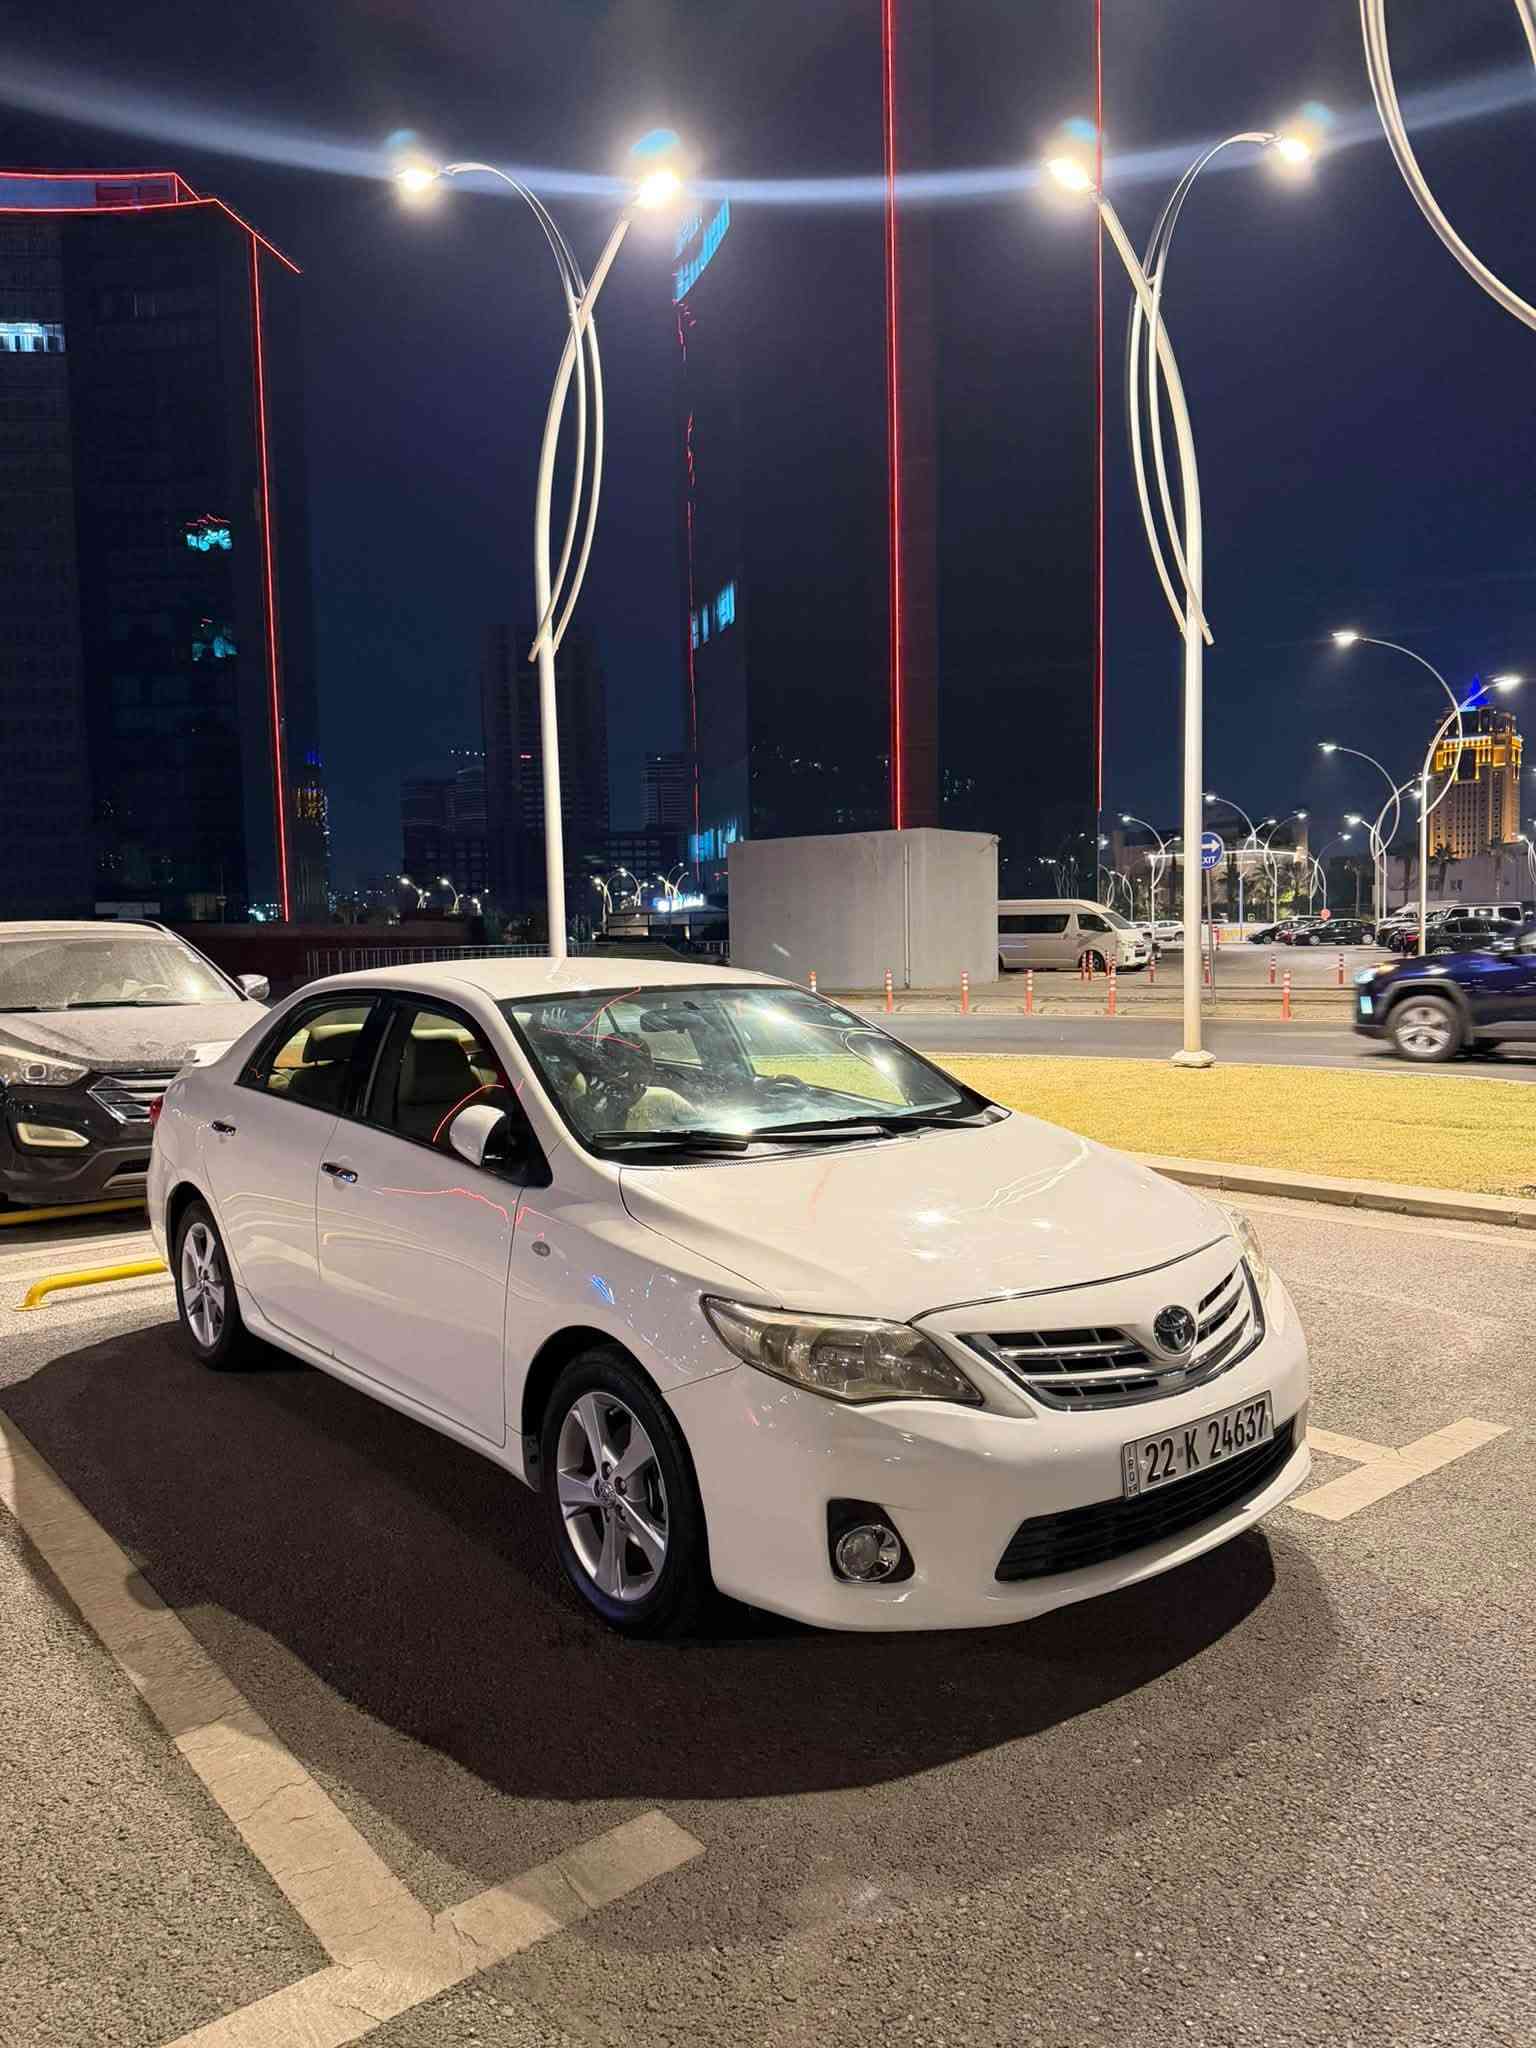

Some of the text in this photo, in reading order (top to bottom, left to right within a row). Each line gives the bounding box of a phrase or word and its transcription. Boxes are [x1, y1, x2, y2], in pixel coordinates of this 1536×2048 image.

[1201, 855, 1216, 865] XIT
[1145, 1400, 1266, 1483] 22 K 24637
